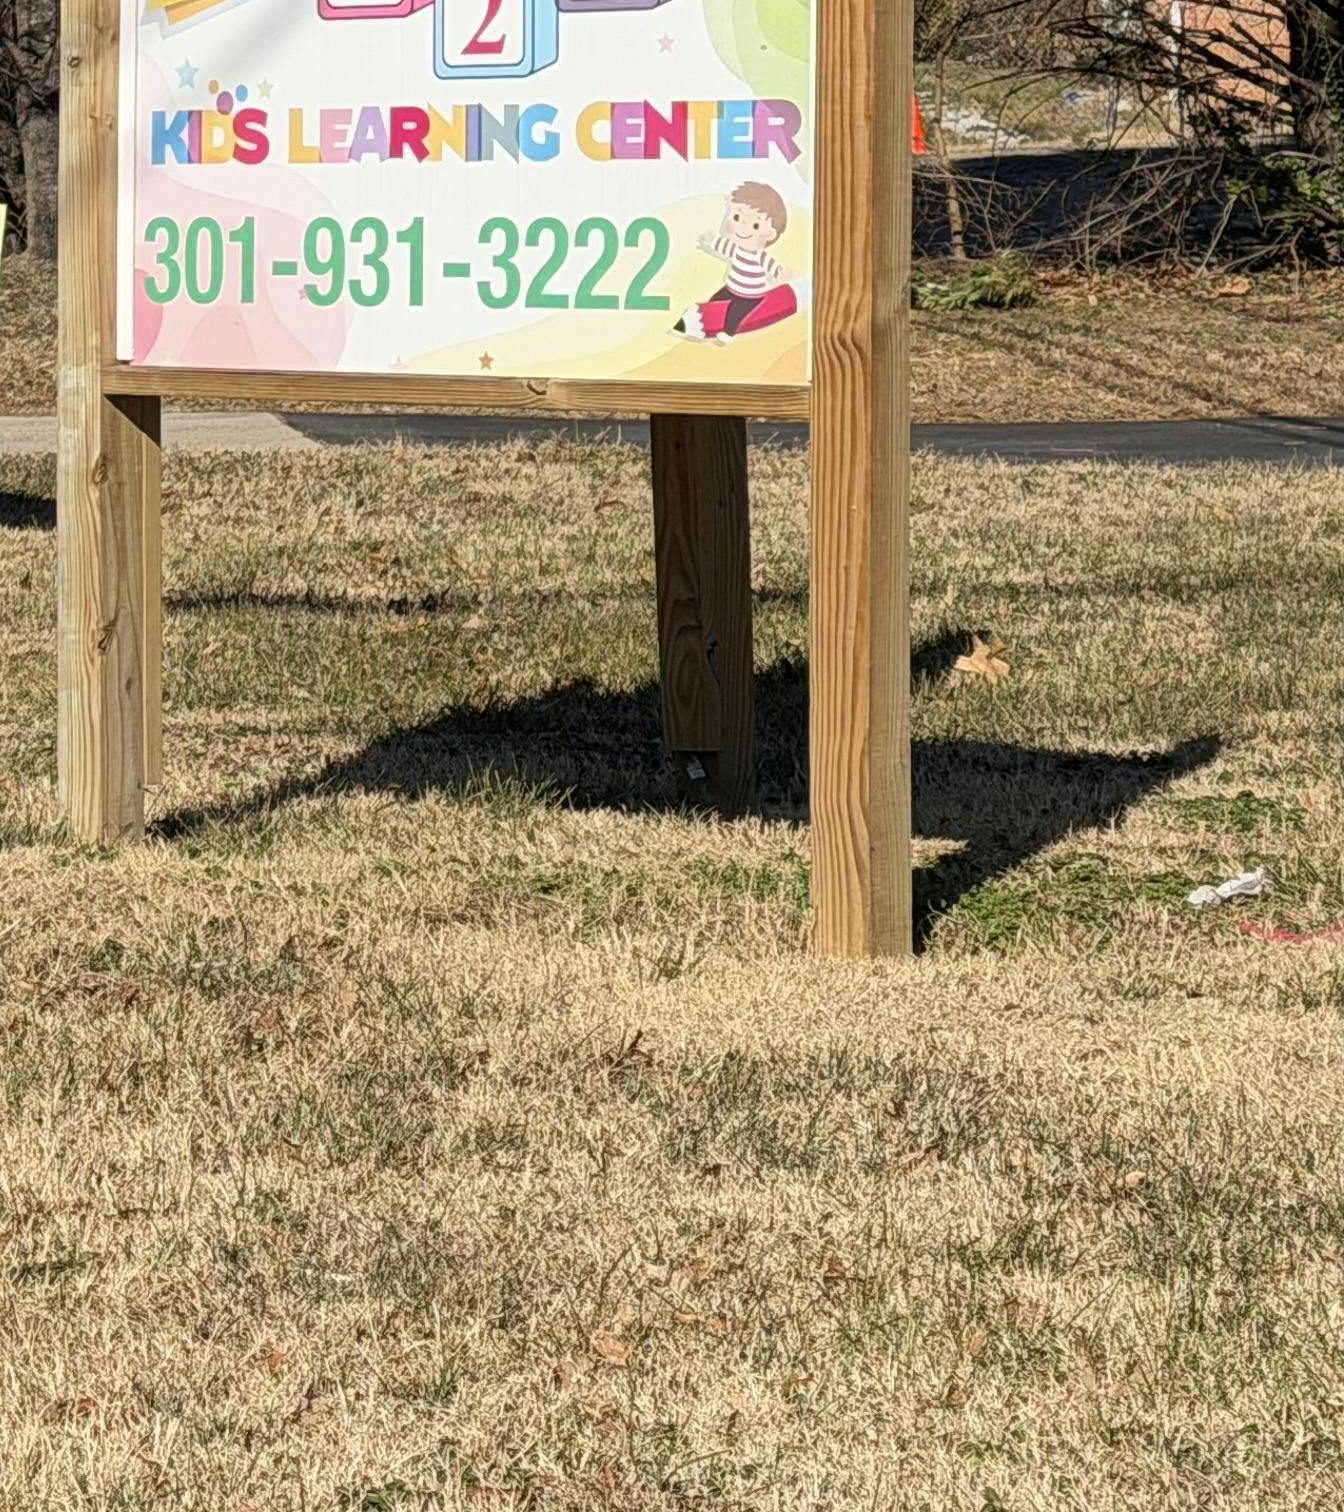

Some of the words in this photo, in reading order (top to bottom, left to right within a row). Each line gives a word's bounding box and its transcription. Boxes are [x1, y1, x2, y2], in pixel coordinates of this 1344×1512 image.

[151, 106, 270, 166] KIDS
[288, 102, 561, 165] LEARNING
[575, 98, 803, 165] CENTER
[143, 216, 671, 311] 301-931-3222
